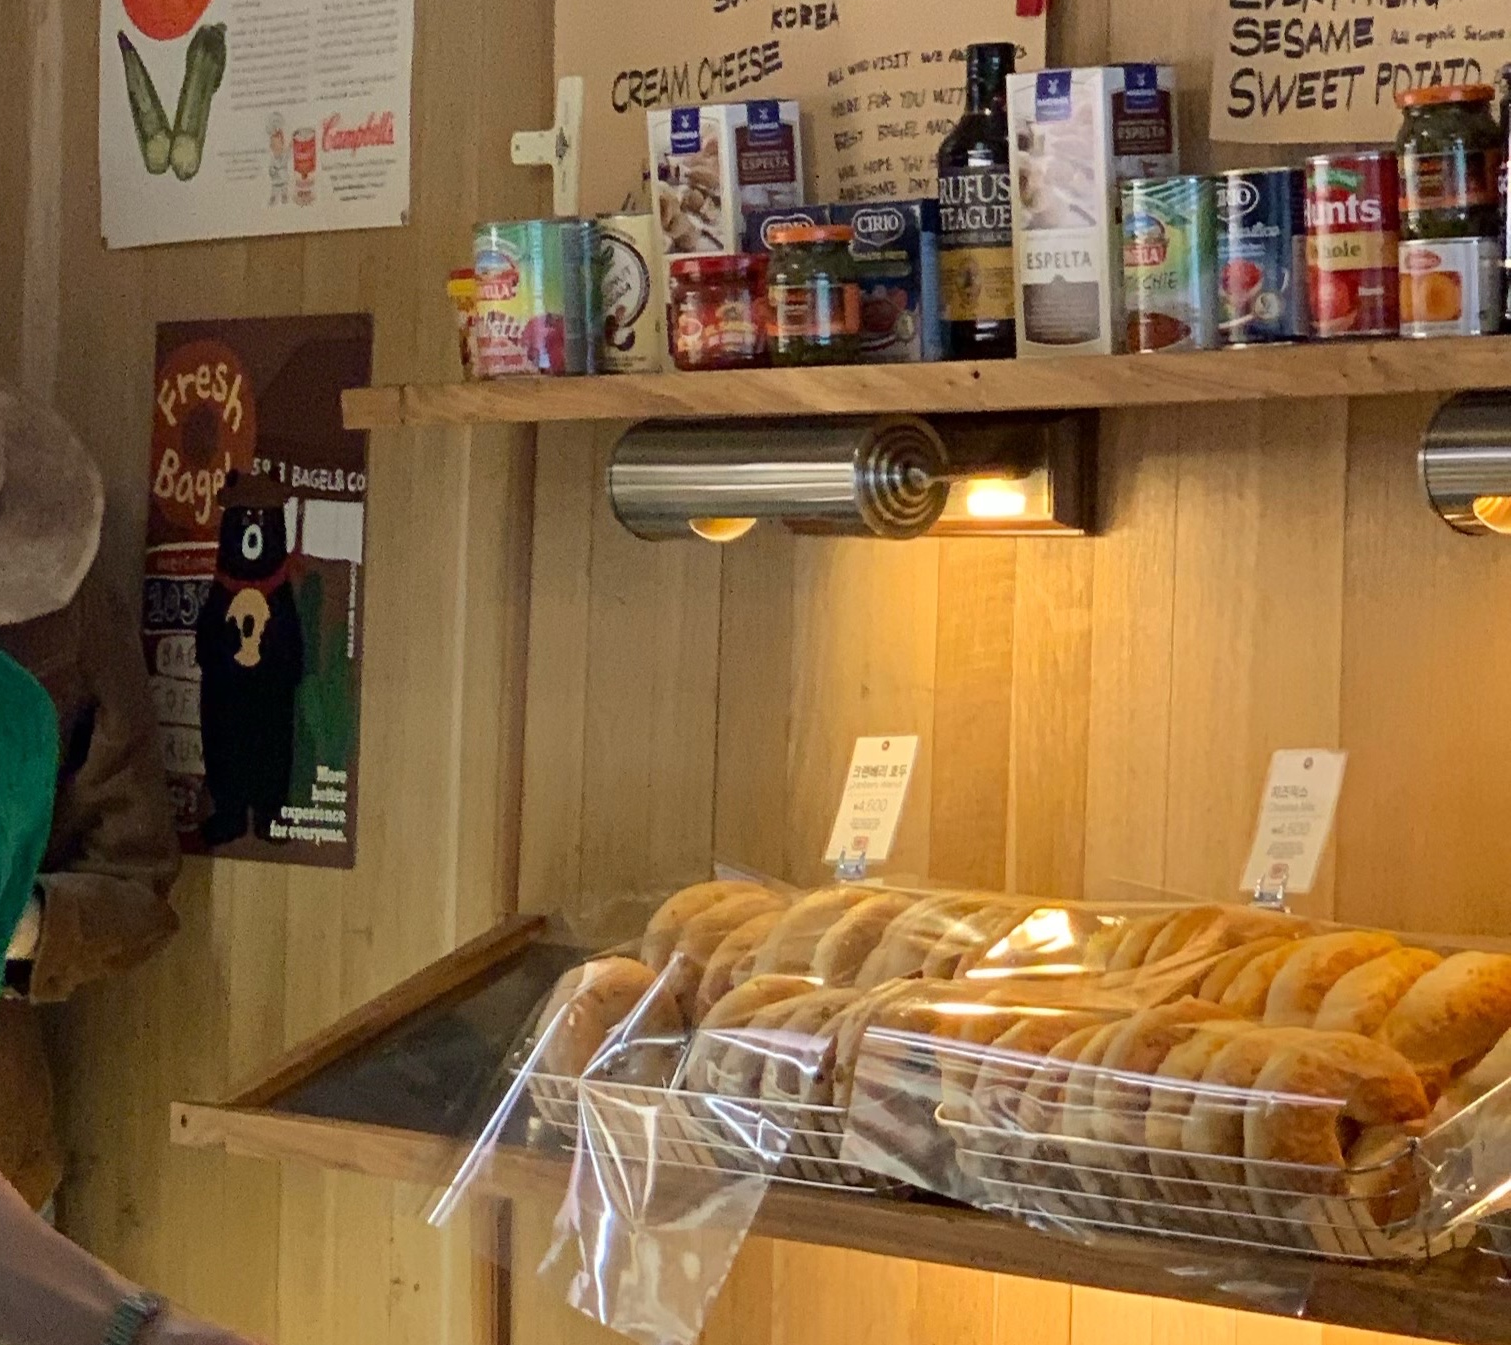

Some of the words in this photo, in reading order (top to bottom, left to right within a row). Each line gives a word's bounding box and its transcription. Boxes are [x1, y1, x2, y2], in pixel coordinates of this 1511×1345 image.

[771, 0, 839, 33] KOREA
[1229, 16, 1375, 59] SESAME
[612, 62, 690, 113] CREAM
[698, 41, 782, 100] CHEESE
[933, 86, 966, 106] WIT
[1227, 65, 1365, 119] SWEET
[940, 175, 1010, 203] RUFUS
[1026, 250, 1093, 270] ESPELTA
[157, 363, 243, 432] Fresh
